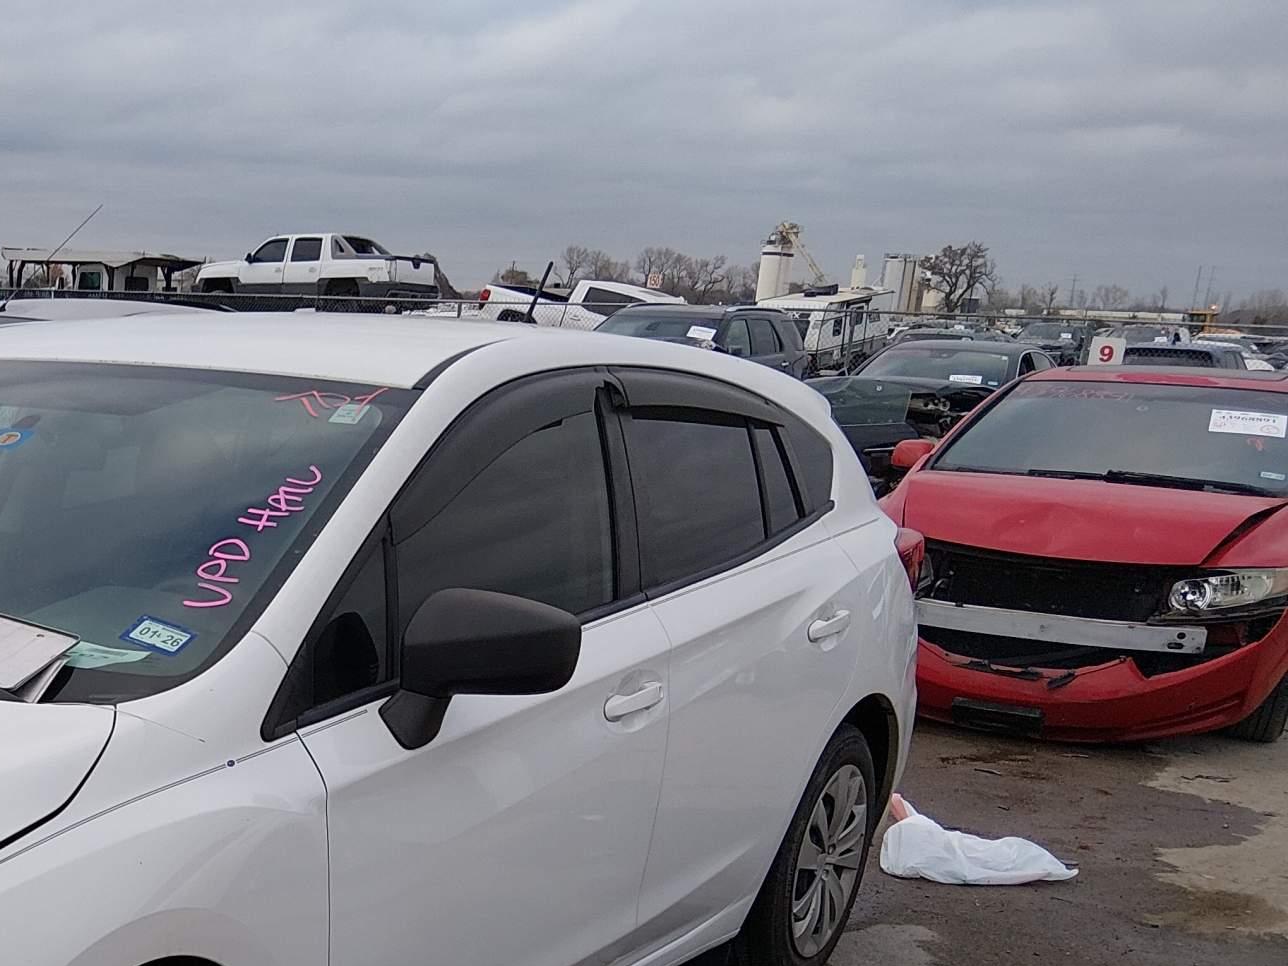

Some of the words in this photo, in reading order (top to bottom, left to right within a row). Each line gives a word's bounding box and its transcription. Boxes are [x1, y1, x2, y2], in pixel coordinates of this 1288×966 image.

[1099, 345, 1114, 362] 9
[237, 465, 322, 532] HAIL
[139, 626, 158, 639] 01
[161, 634, 183, 647] 26
